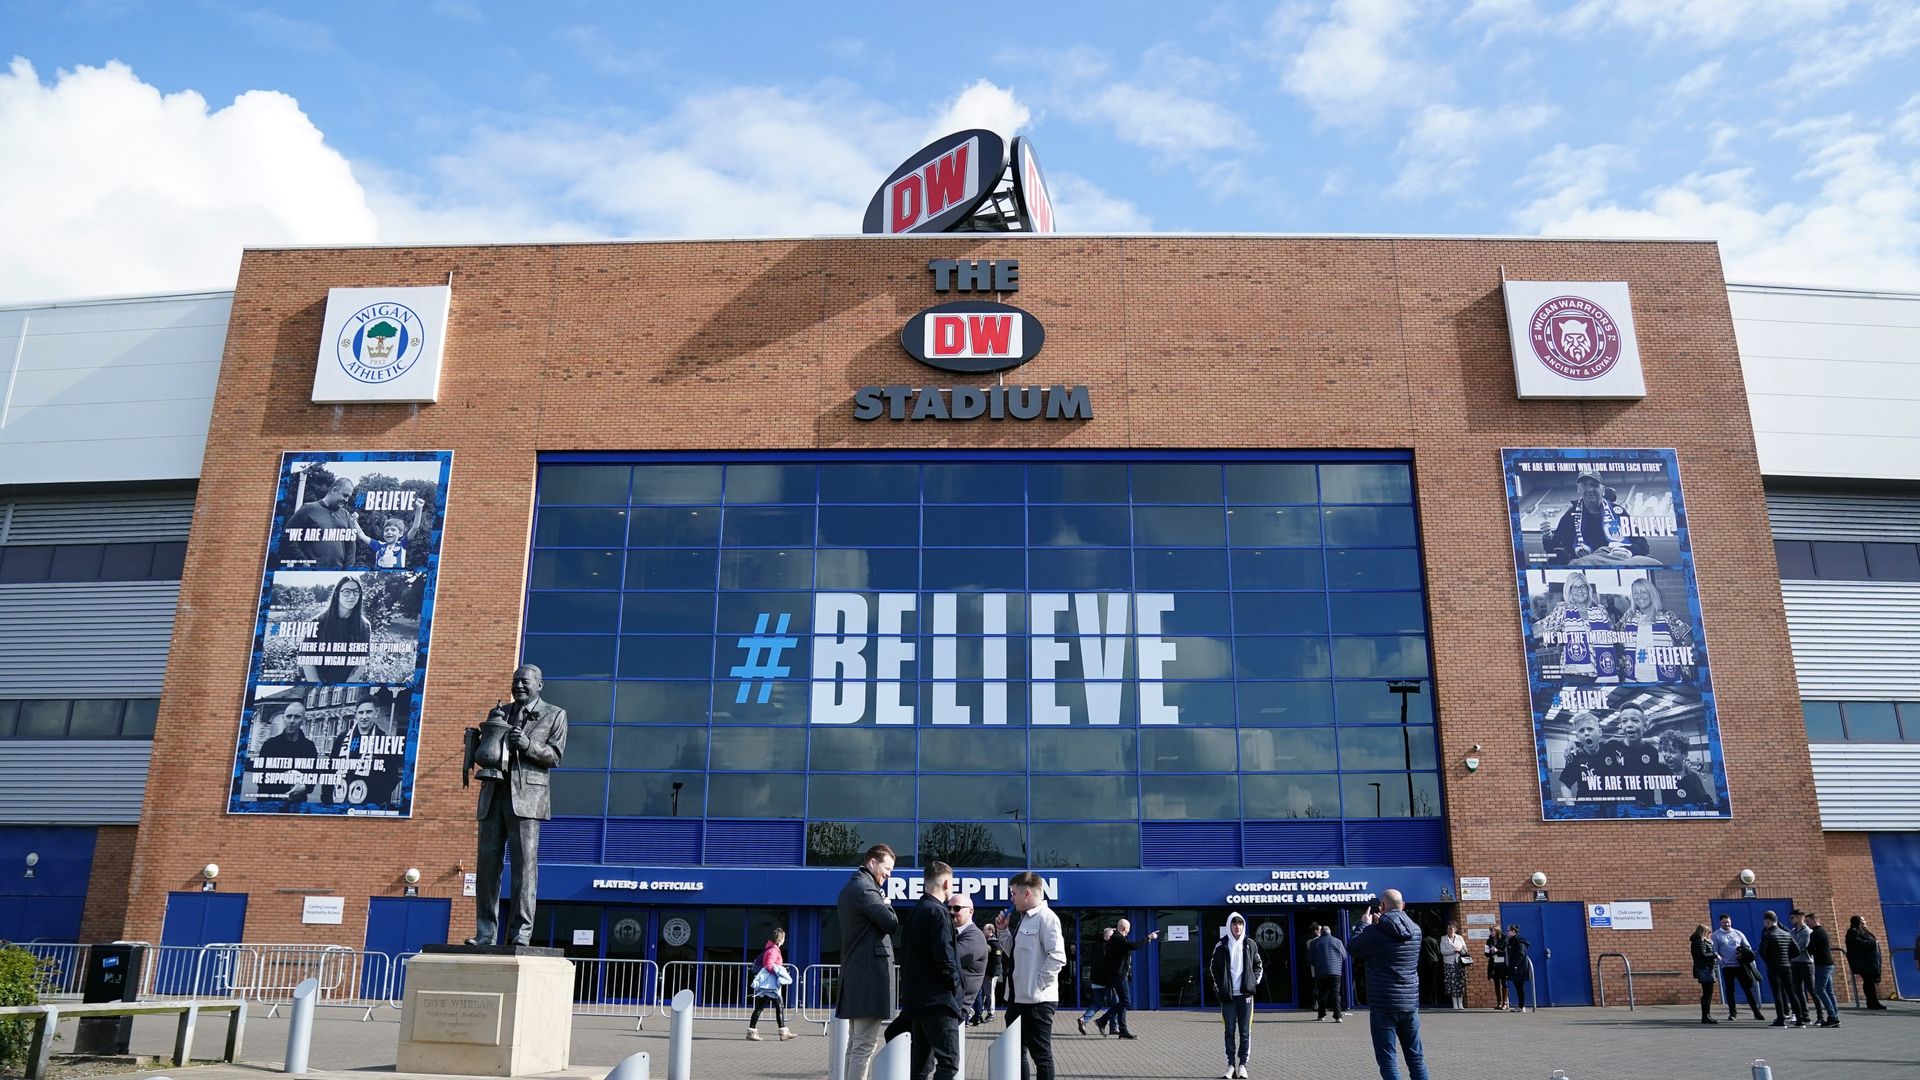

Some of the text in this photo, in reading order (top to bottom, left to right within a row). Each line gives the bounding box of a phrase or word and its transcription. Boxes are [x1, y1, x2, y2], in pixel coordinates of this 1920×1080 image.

[892, 142, 969, 233] DW
[929, 259, 1019, 292] THE
[355, 305, 412, 323] WIGAN
[1534, 300, 1613, 332] WIGAN WARRIORS
[933, 315, 1013, 356] DW
[346, 360, 407, 380] ATHLETIC
[1544, 355, 1580, 376] ANCIENT
[1591, 355, 1613, 374] LOYAL
[853, 385, 1093, 420] STADIUM
[1532, 462, 1543, 472] ARE
[1544, 462, 1556, 472] ONE
[1557, 462, 1577, 472] FAMILY
[1577, 462, 1593, 472] WHO
[1593, 462, 1608, 472] LOOK
[1608, 462, 1626, 472] AFTER
[1626, 462, 1641, 472] EACH
[355, 490, 417, 511] #BELIEVE
[285, 528, 303, 541] "WE
[304, 528, 321, 541] ARE
[270, 621, 319, 638] #BELIEVE
[318, 643, 326, 652] IS
[326, 643, 332, 652] A
[332, 643, 347, 652] REAL
[348, 643, 369, 652] SENSE
[370, 643, 378, 652] OF
[380, 643, 412, 653] OPTIMISM
[1637, 647, 1695, 666] #BELIEVE
[297, 656, 323, 665] AROUND
[324, 656, 346, 665] WIGAN
[729, 593, 1179, 725] #BELIEVE
[1552, 690, 1610, 710] #BELIEVE
[351, 736, 406, 754] #BELIEVE
[265, 757, 293, 769] MATTER
[294, 758, 315, 769] WHAT
[316, 758, 330, 769] LIFE
[331, 758, 362, 770] THROWS
[362, 759, 373, 771] AT
[373, 759, 386, 772] US,
[252, 772, 263, 783] WE
[264, 772, 297, 784] SUPPORT
[299, 773, 318, 784] EACH
[1604, 775, 1622, 790] ARE
[1623, 775, 1641, 790] THE
[1643, 775, 1682, 790] FUTURE"
[1271, 870, 1330, 880] DIRECTORS
[593, 879, 704, 890] PLAYERS & OFFICIALS
[888, 878, 1058, 900] REEPTIN
[1235, 881, 1368, 892] CORPORATE HOSPITALITY
[1226, 894, 1293, 904] CONFERENCE
[1295, 894, 1304, 903] &
